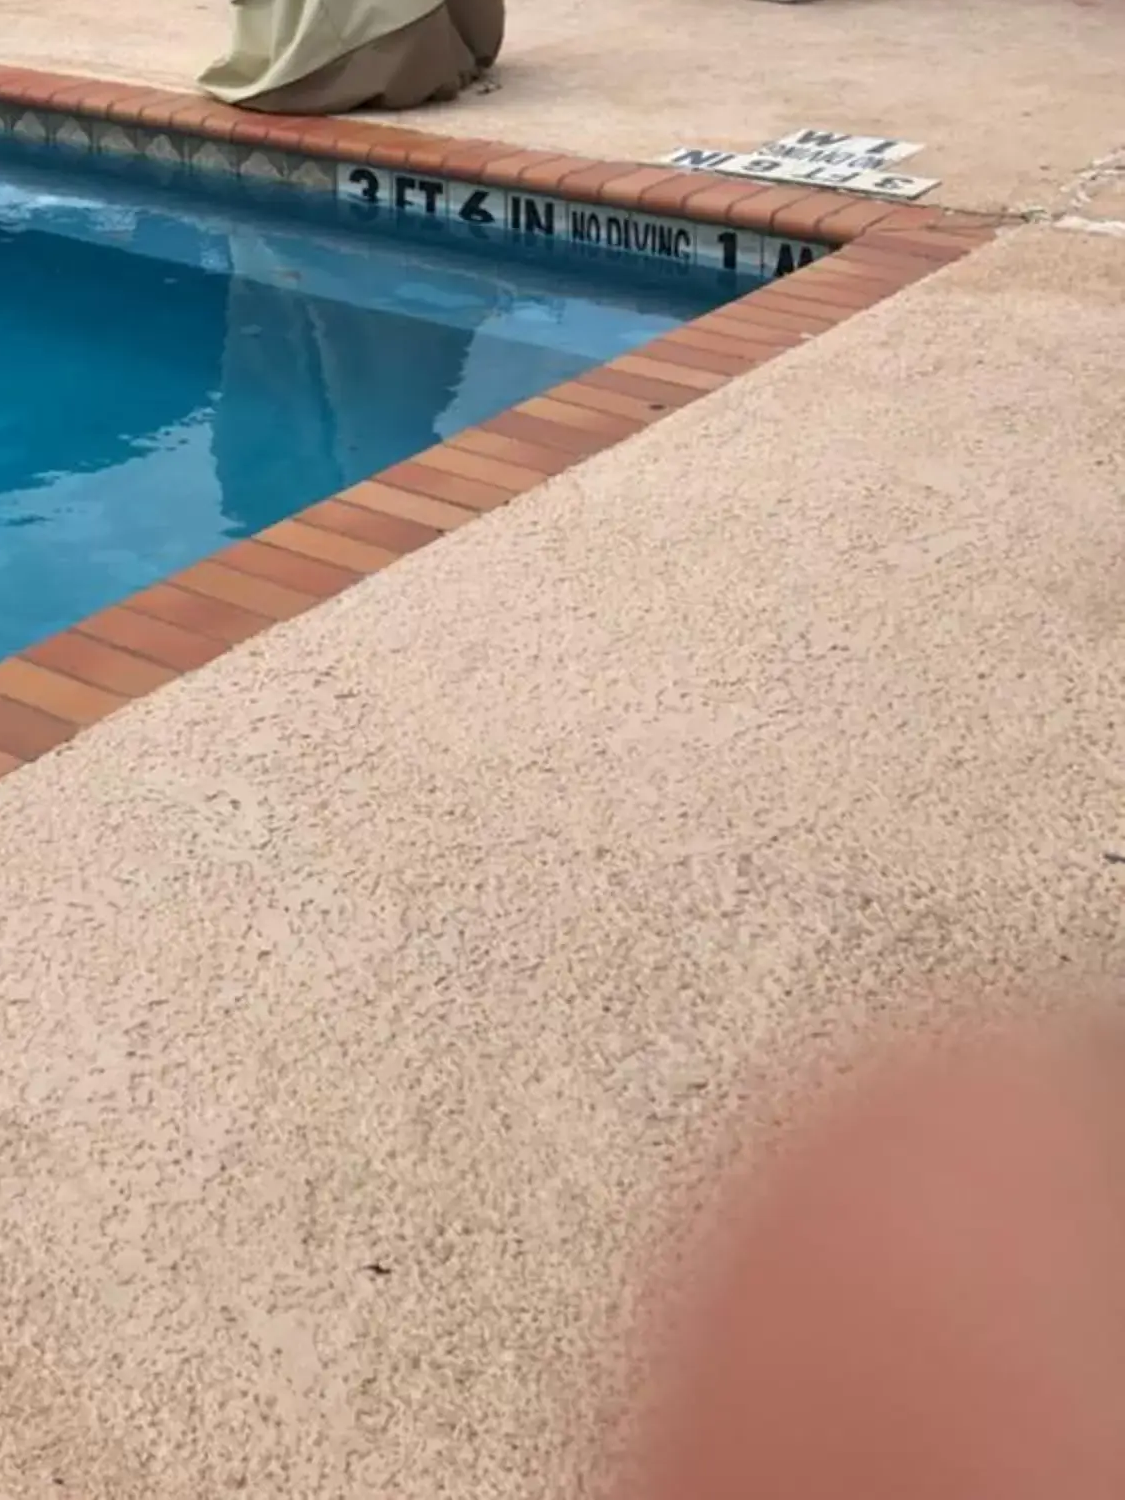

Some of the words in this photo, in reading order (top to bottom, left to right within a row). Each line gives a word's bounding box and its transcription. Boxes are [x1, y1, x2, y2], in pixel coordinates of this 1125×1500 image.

[394, 176, 444, 214] FT
[458, 189, 496, 224] 6
[511, 196, 555, 235] IN
[571, 210, 601, 247] NO
[605, 215, 691, 261] DIVING
[716, 231, 738, 270] 1
